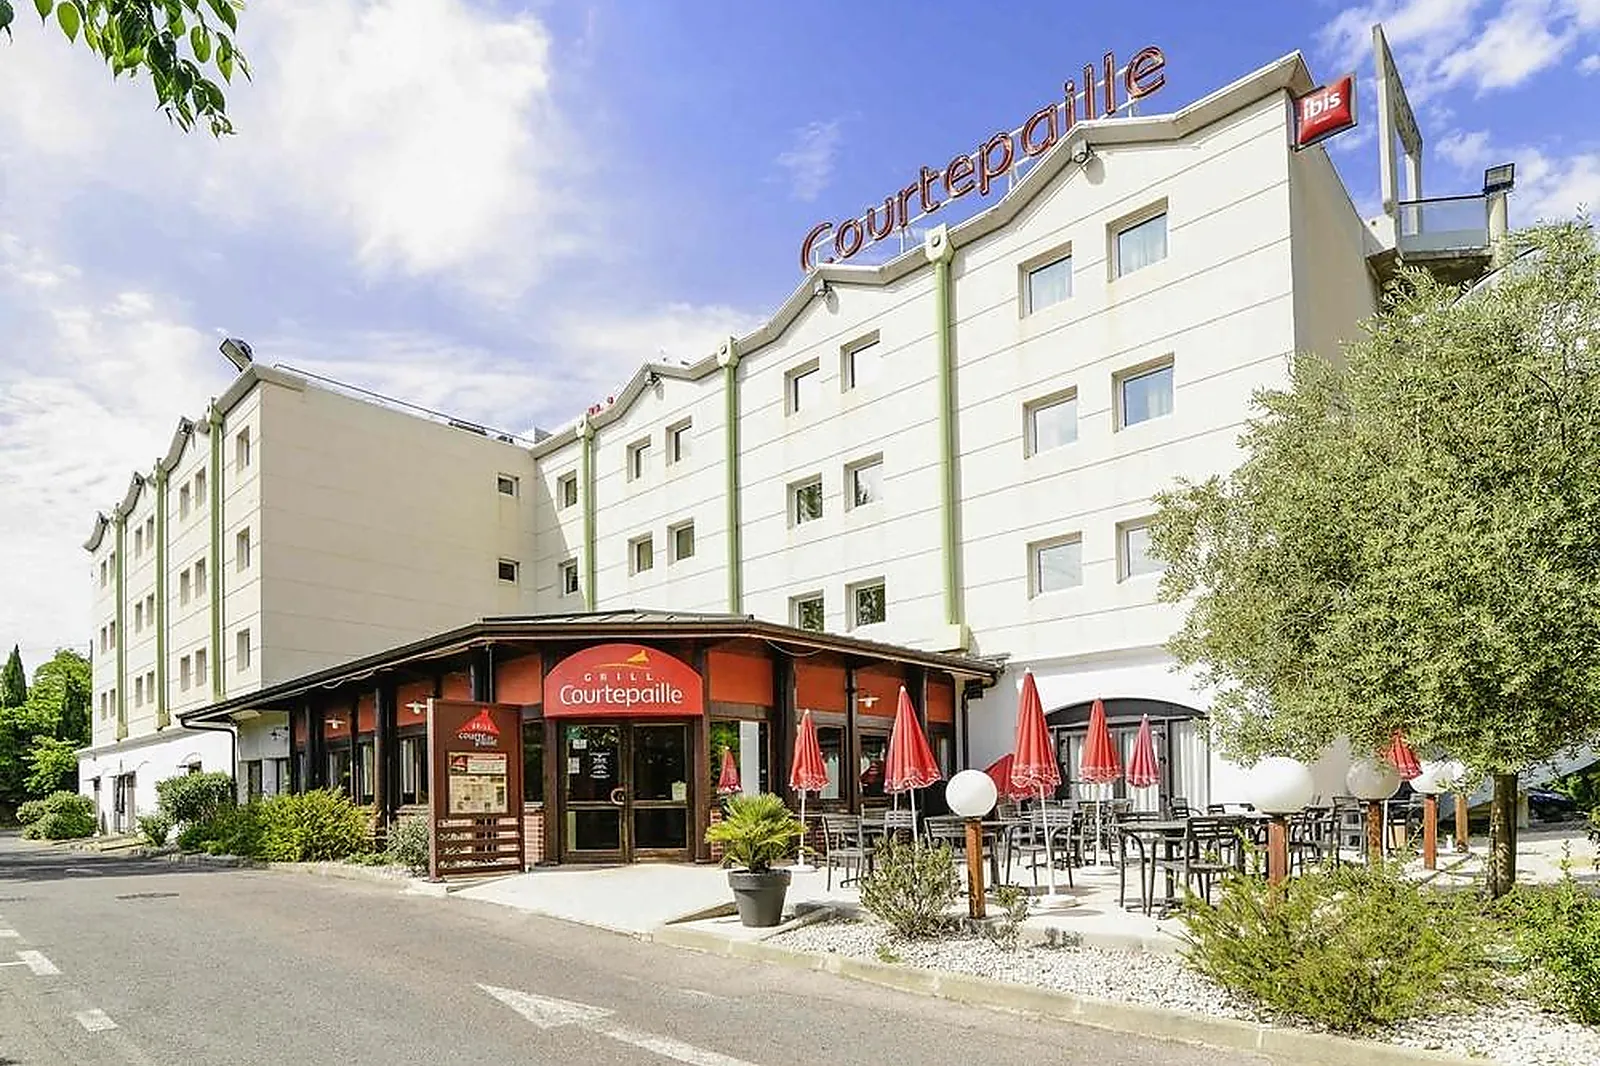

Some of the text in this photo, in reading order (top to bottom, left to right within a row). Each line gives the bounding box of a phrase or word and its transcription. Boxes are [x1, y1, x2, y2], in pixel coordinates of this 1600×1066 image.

[1303, 92, 1342, 119] ibis
[801, 45, 1166, 271] Courtepaille
[584, 672, 653, 682] GRILL
[560, 682, 683, 707] Courtepaille
